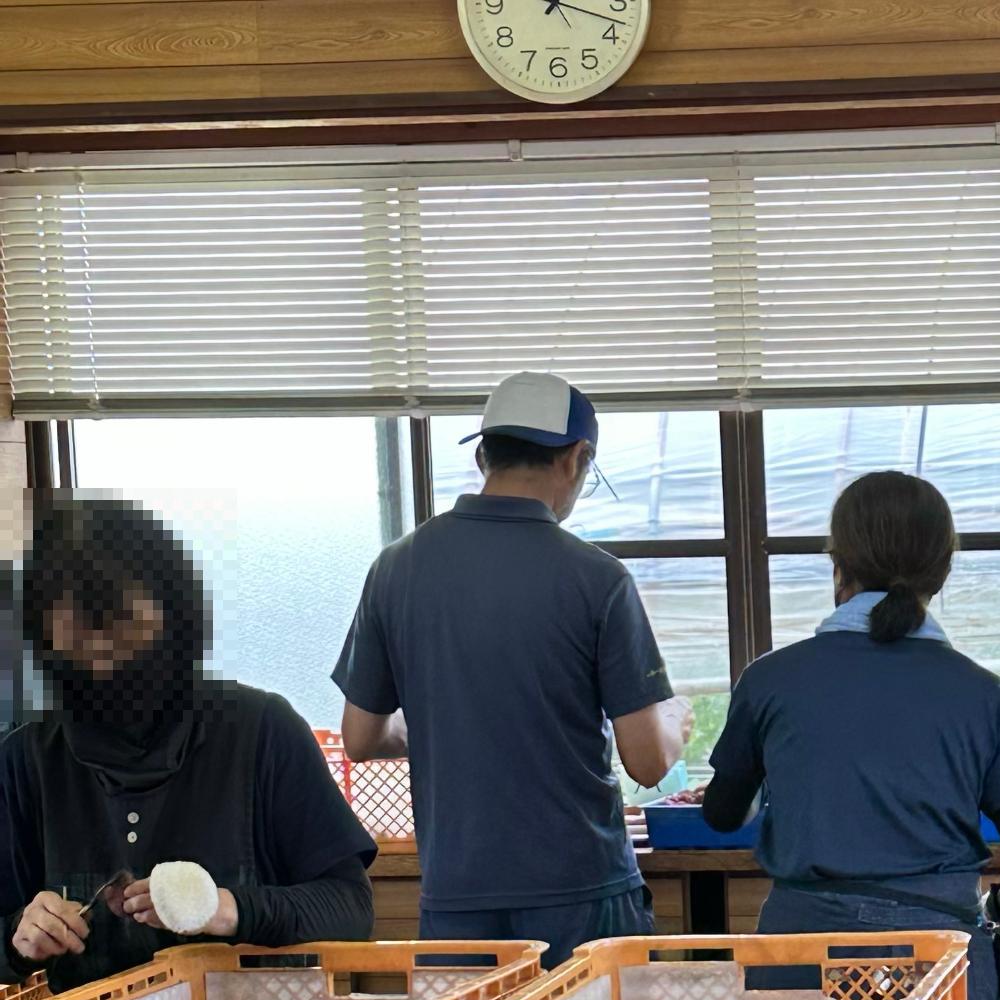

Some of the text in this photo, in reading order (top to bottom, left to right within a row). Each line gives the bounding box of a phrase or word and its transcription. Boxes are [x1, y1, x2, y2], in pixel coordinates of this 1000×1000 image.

[496, 26, 514, 48] 8
[602, 23, 620, 45] 4
[520, 50, 537, 72] 7
[549, 56, 568, 78] 6
[581, 48, 599, 70] 5
